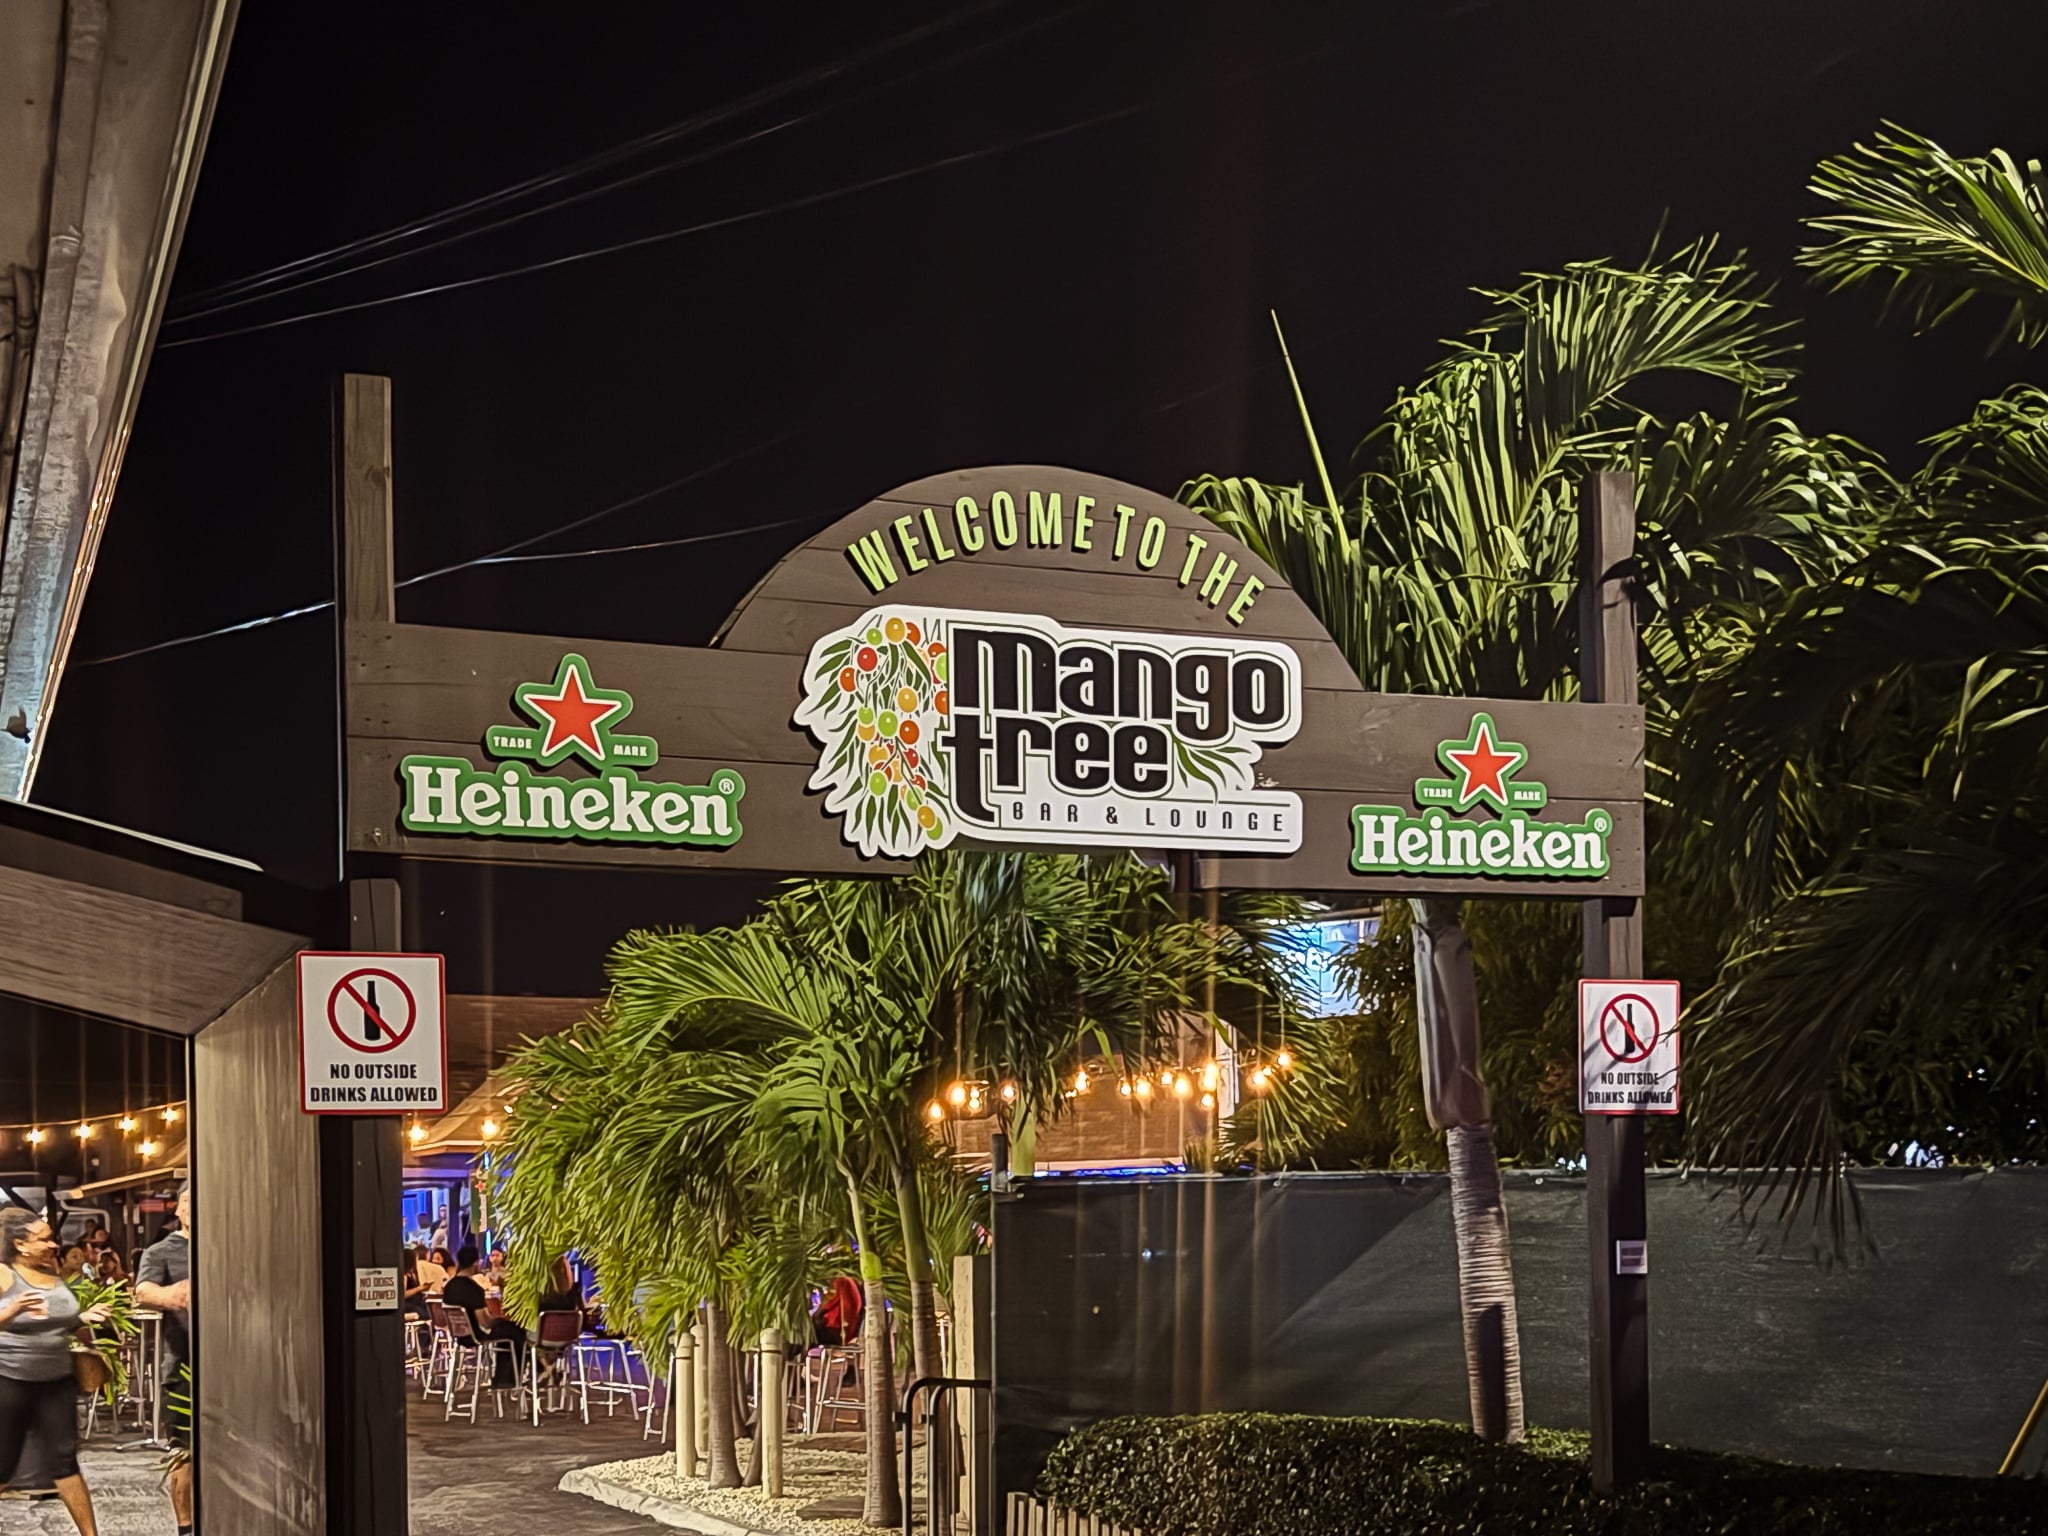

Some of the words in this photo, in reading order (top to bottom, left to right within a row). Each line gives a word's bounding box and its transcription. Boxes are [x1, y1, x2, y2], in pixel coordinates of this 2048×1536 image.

[847, 490, 1096, 592] WELCOME
[1112, 504, 1166, 568] TO
[1179, 533, 1266, 625] THE
[952, 627, 1286, 742] mango
[494, 736, 532, 749] TRADE
[613, 745, 647, 757] MARK
[940, 713, 1169, 823] tree
[1423, 787, 1453, 798] TRADE
[1514, 790, 1541, 801] MARK
[1011, 801, 1079, 824] BAR
[1105, 805, 1120, 825] &
[1145, 808, 1284, 832] LOUNGE
[330, 1063, 350, 1079] NO
[354, 1063, 417, 1079] OUTSIDE
[1601, 1072, 1614, 1085] NO
[1617, 1072, 1660, 1085] OUTSIDE
[310, 1086, 367, 1102] DRINKS
[370, 1086, 437, 1102] ALLOWED
[1587, 1091, 1625, 1104] DRINKS
[359, 1277, 371, 1288] NO
